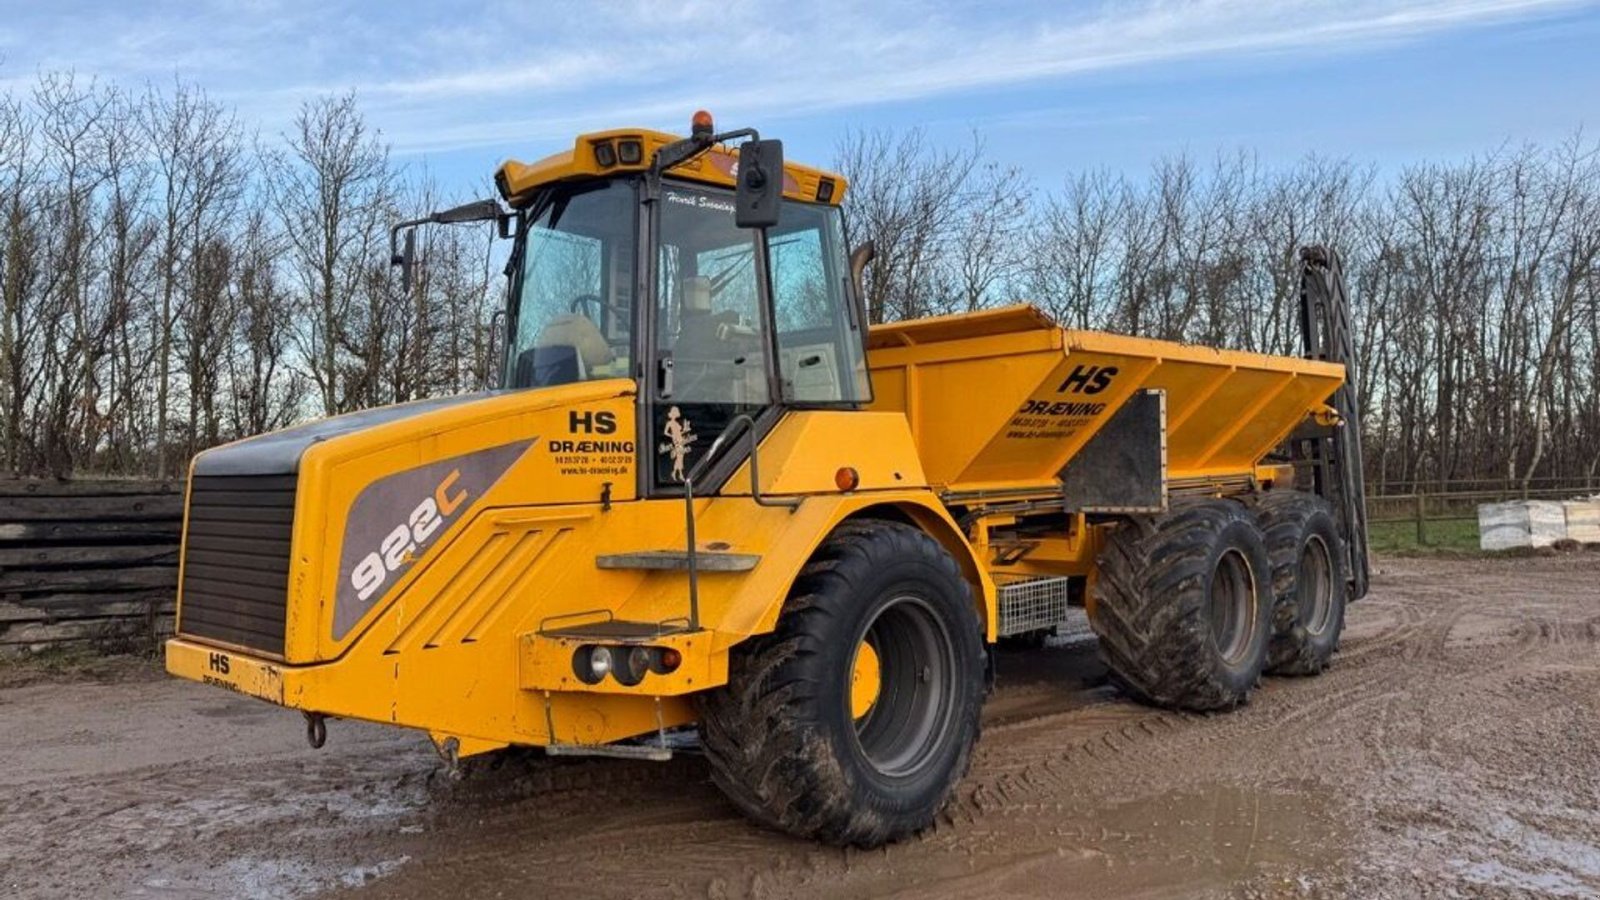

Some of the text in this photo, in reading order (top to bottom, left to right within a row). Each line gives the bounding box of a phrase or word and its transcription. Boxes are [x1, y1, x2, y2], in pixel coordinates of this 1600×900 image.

[1056, 364, 1119, 395] HS
[569, 410, 617, 435] HS
[549, 440, 634, 453] DRÆNING
[351, 468, 469, 601] 922C
[209, 652, 230, 675] HS
